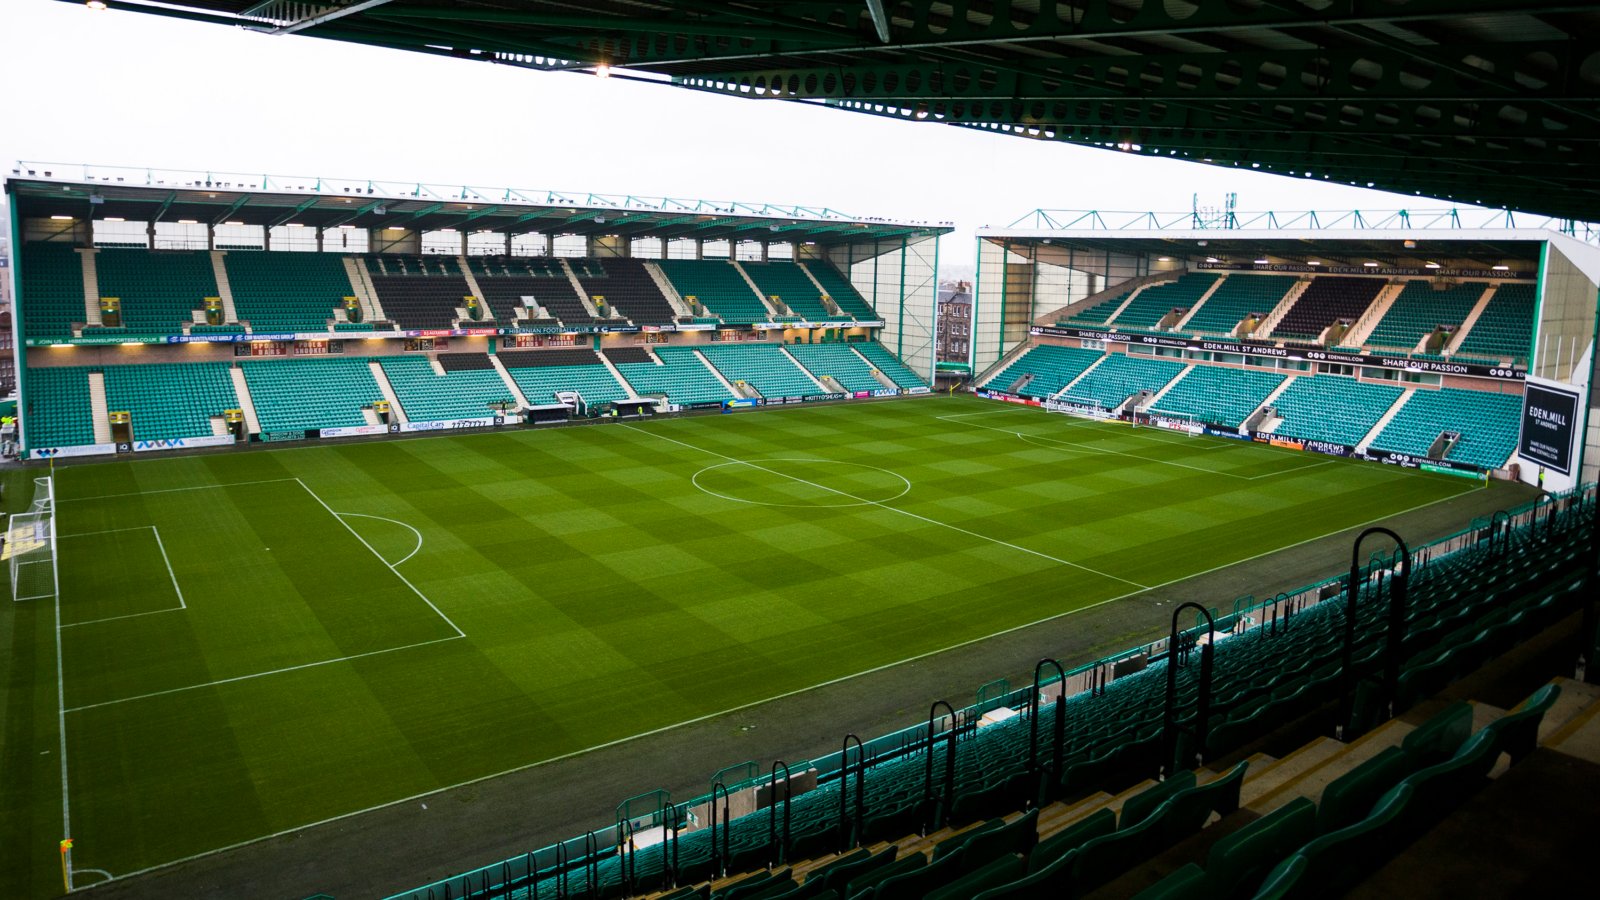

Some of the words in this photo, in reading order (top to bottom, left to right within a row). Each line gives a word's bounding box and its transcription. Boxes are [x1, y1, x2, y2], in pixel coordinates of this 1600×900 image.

[1204, 342, 1239, 352] EDEN.MILL
[1252, 346, 1287, 356] ANDREWS
[1383, 359, 1408, 368] SHARE
[1431, 363, 1468, 373] PASSION
[1529, 406, 1566, 426] EDEN.MILL
[407, 421, 428, 430] Capital
[1540, 420, 1557, 431] ANDREWS
[1257, 432, 1294, 443] EDEN.MILL
[1308, 440, 1344, 452] ANDREWS
[1412, 458, 1451, 467] EDENMILL.COM
